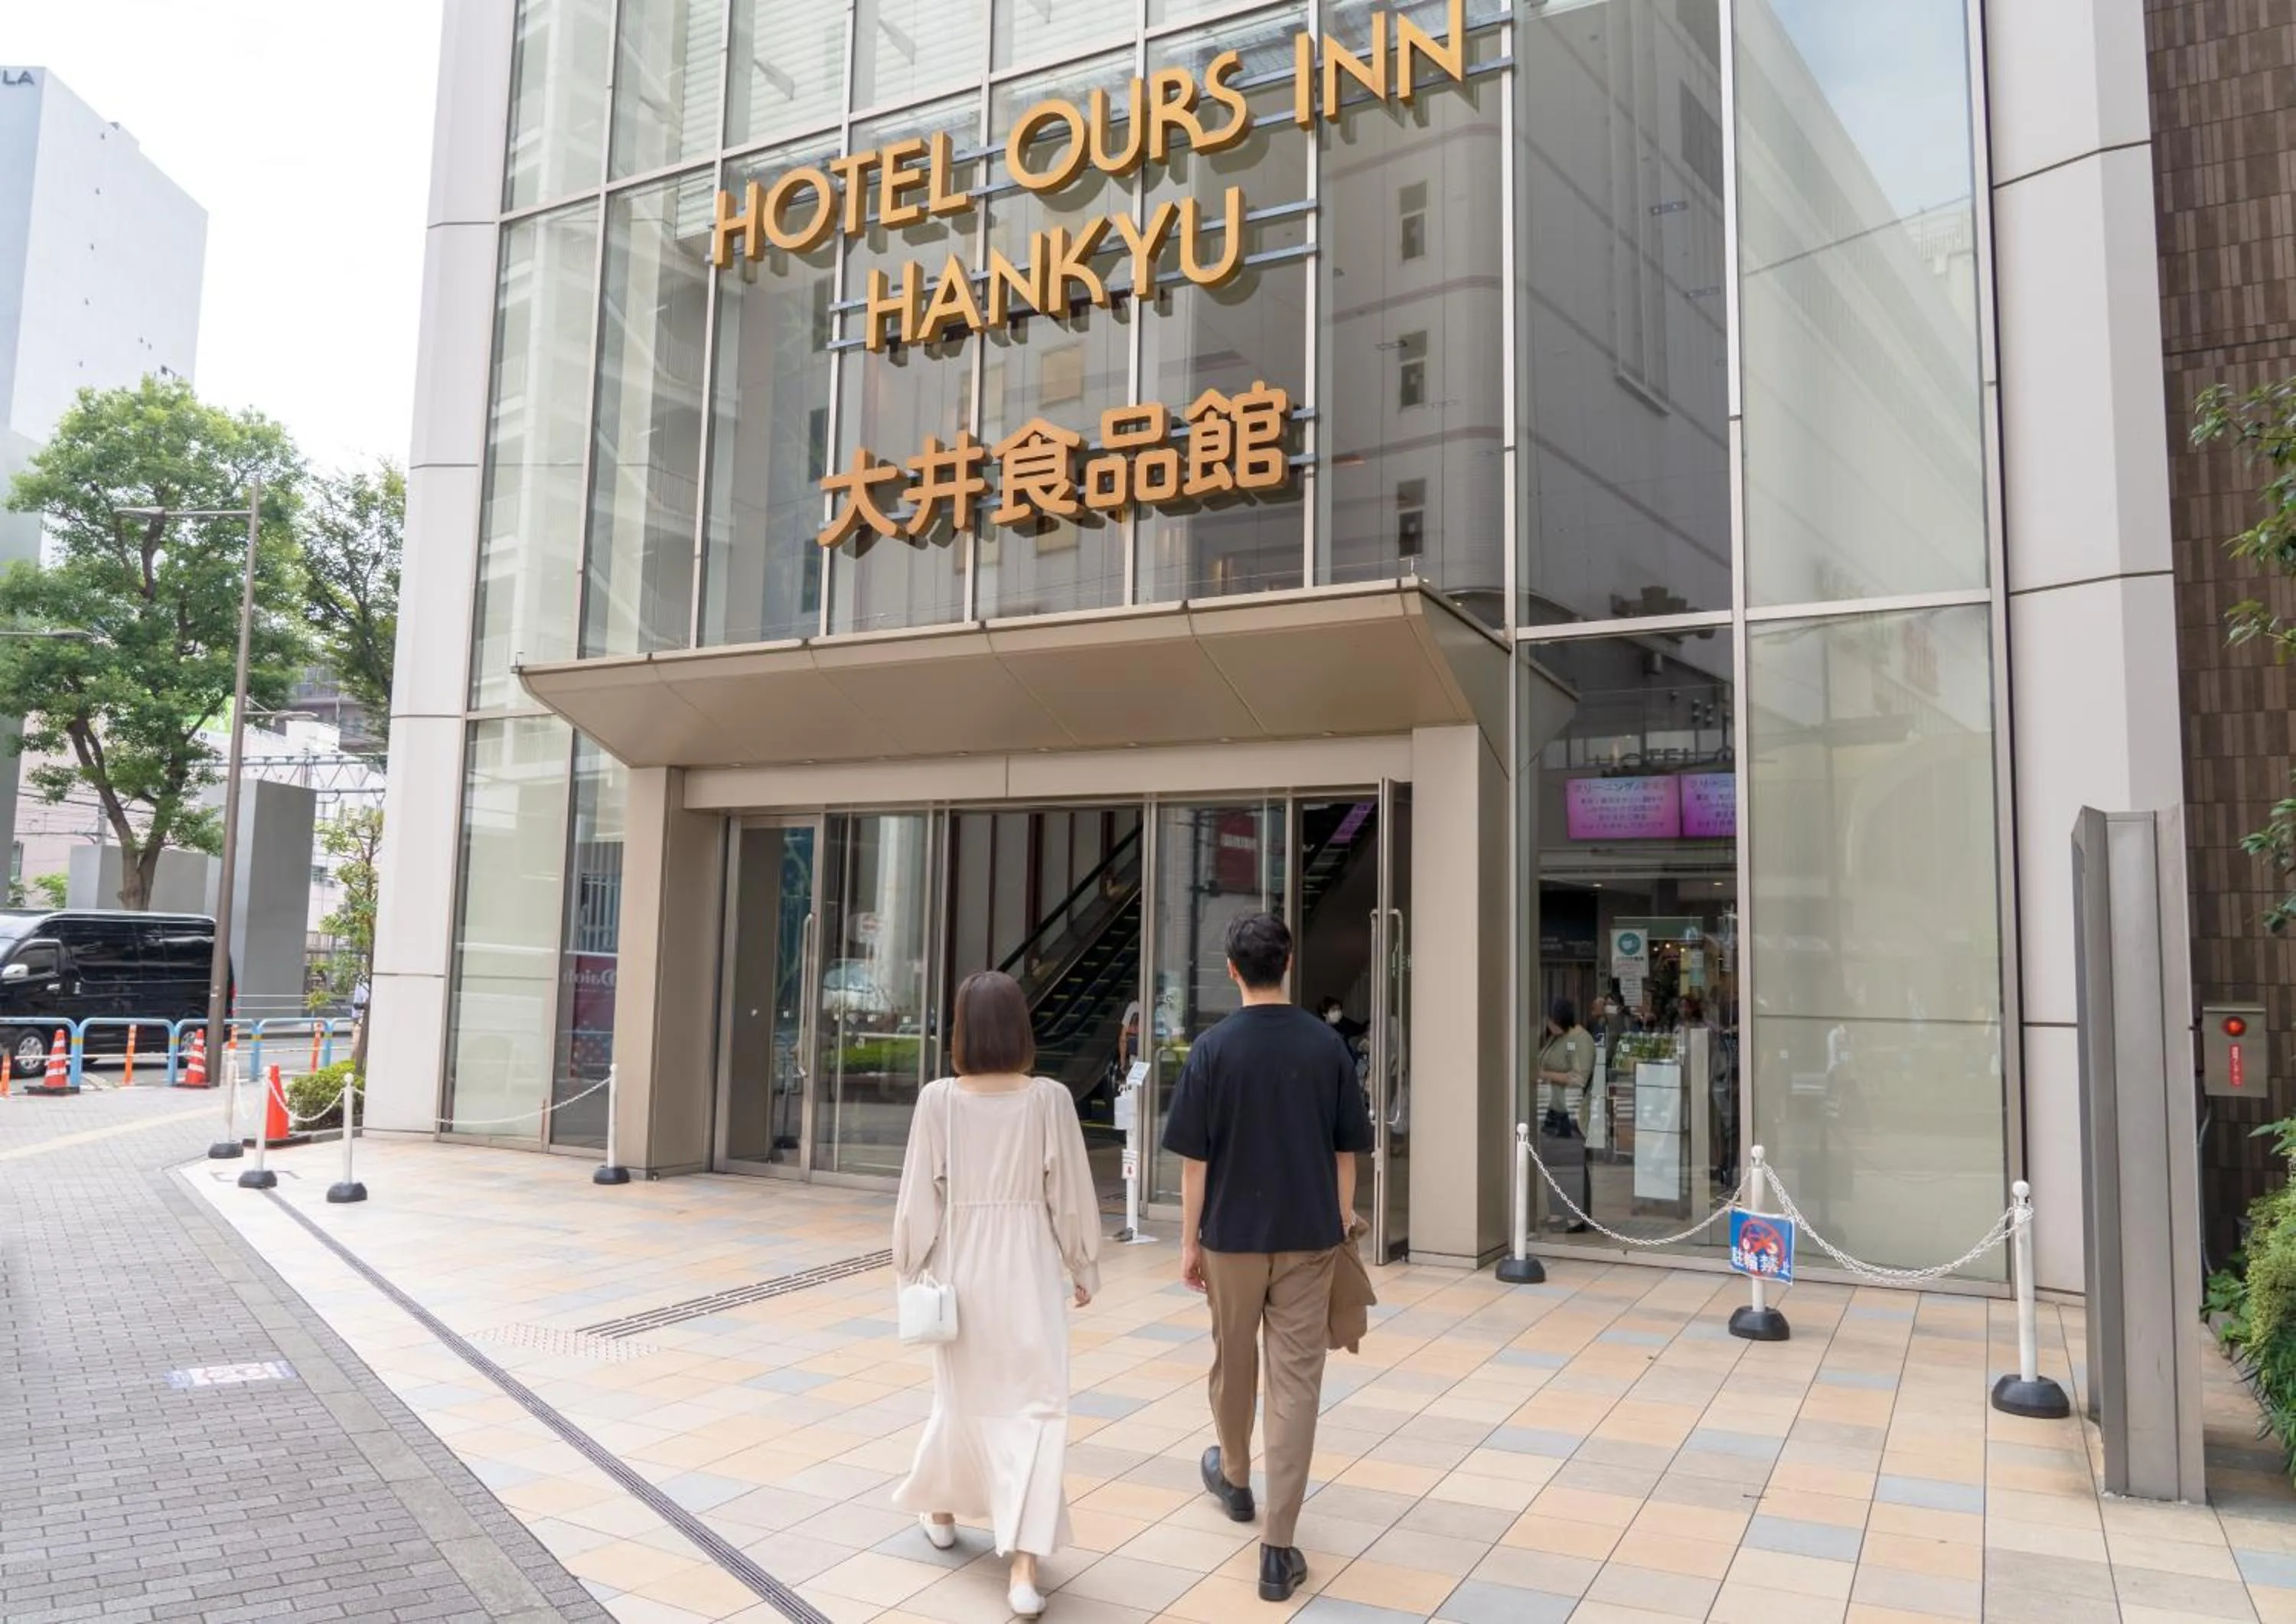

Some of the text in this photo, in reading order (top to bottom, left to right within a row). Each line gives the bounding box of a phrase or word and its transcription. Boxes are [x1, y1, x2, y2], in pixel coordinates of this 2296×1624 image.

[0, 70, 37, 86] LA
[712, 0, 1468, 268] HOTEL OURS INN
[865, 186, 1247, 351] HANKYU
[816, 379, 1292, 548] 大井食品館
